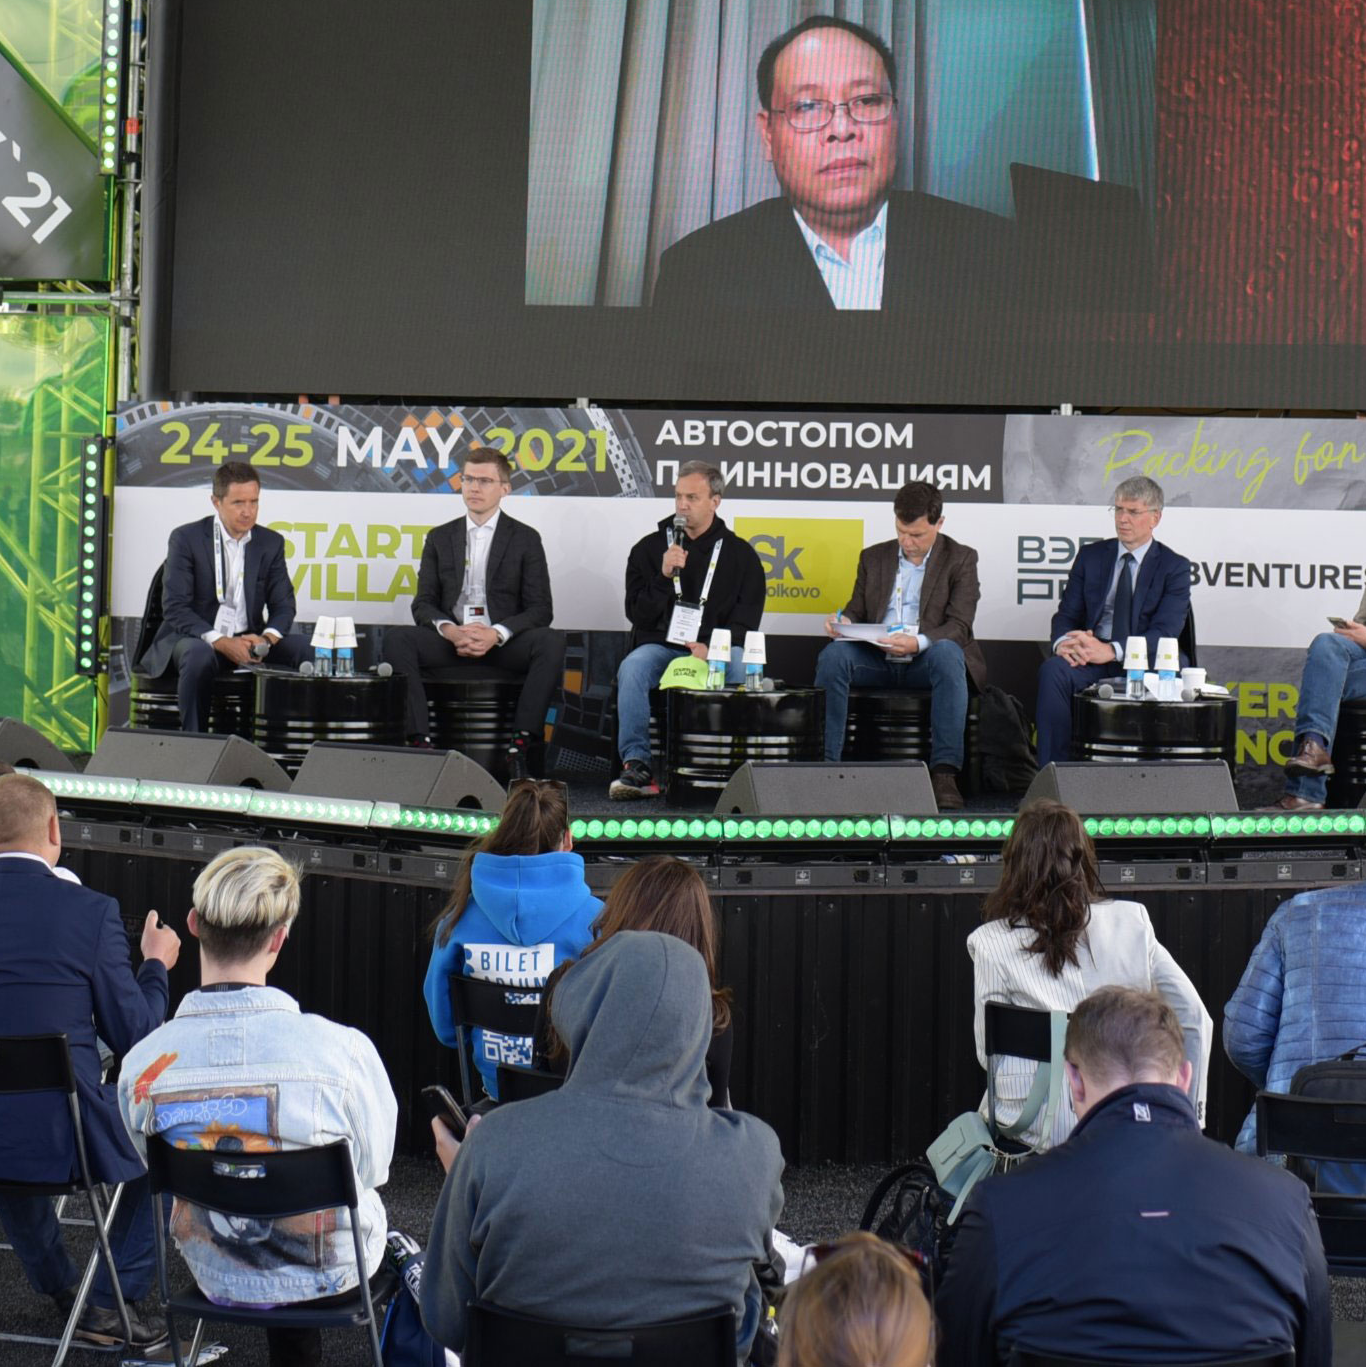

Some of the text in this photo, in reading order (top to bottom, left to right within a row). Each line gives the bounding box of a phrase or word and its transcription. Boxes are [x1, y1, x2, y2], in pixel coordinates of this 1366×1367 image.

[160, 421, 314, 468] 24-25
[336, 424, 464, 470] MAY
[655, 419, 914, 449] АВТОСТОПОМ
[655, 461, 678, 486] П
[1098, 419, 1279, 505] Packing
[1293, 431, 1365, 485] for
[267, 521, 433, 560] START
[1017, 535, 1104, 564] ВЭ
[766, 583, 821, 599] olkovo
[481, 950, 541, 972] BILET
